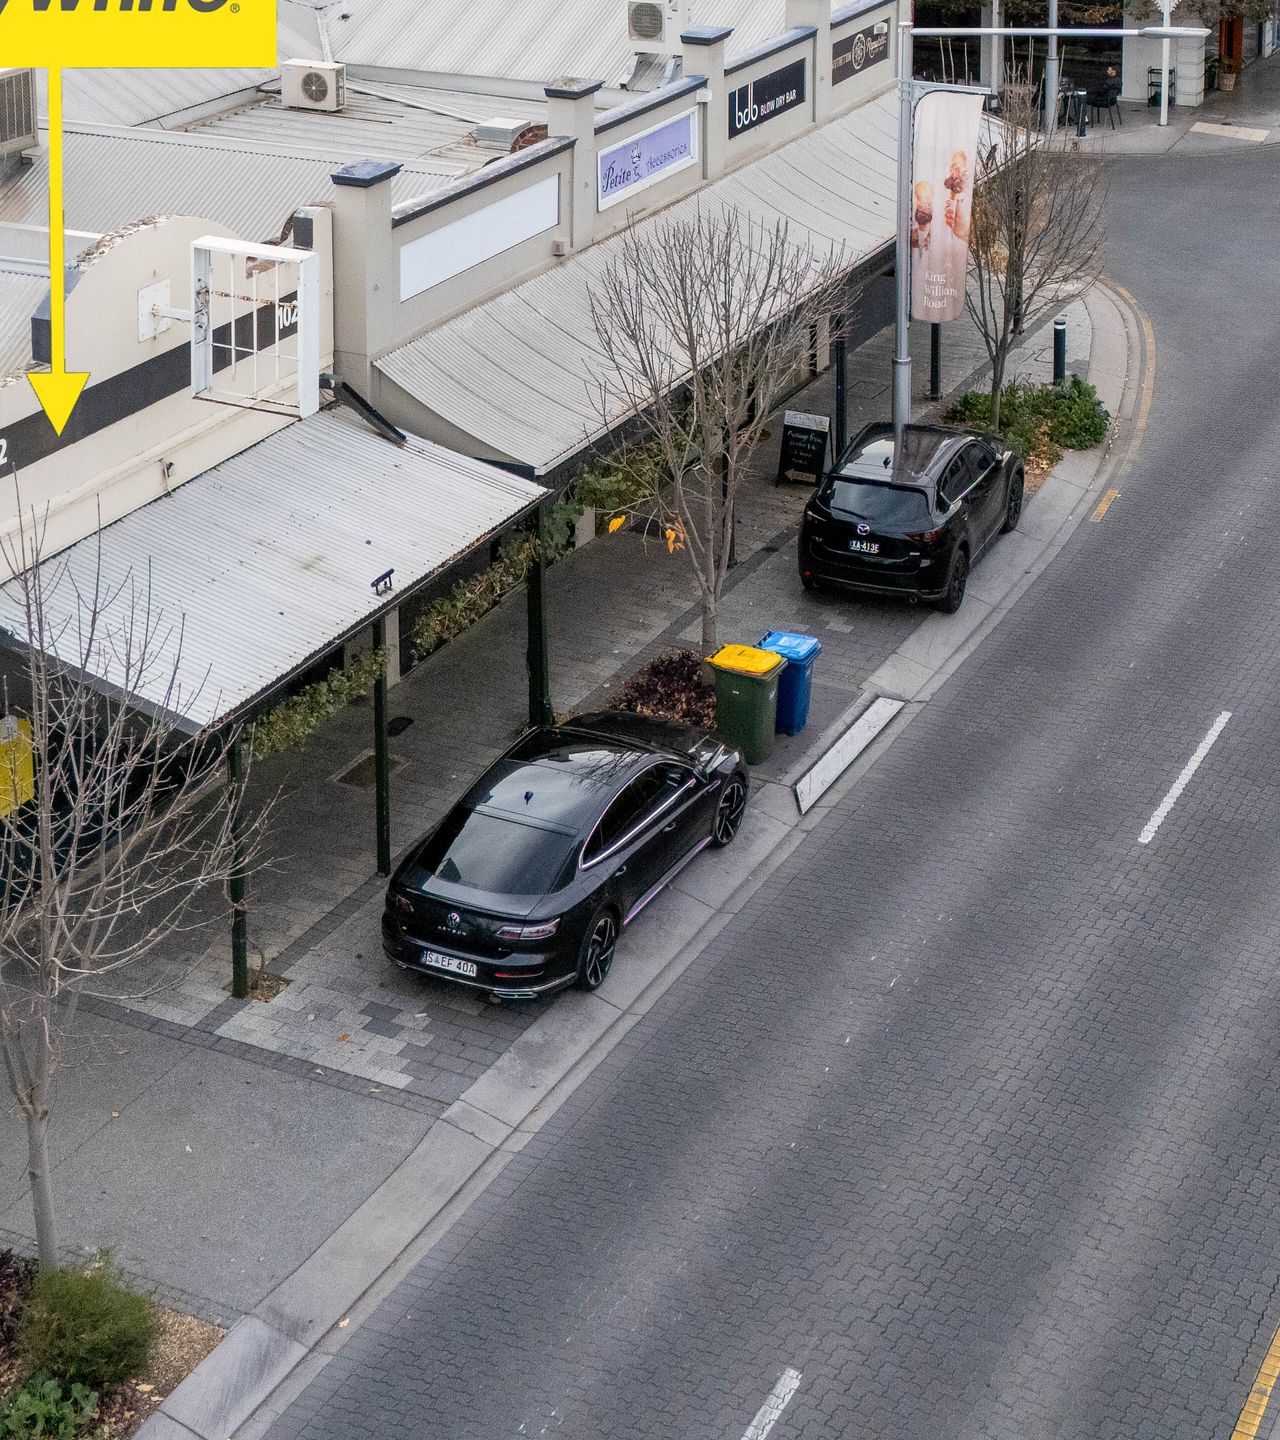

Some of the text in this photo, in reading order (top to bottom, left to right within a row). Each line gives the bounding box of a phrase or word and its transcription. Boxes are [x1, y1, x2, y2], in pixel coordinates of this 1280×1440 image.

[735, 83, 759, 129] bdb
[760, 89, 797, 116] BLOW DRY BAR
[602, 160, 632, 193] Petite
[925, 271, 946, 285] King
[924, 284, 958, 298] William
[922, 295, 947, 309] Road
